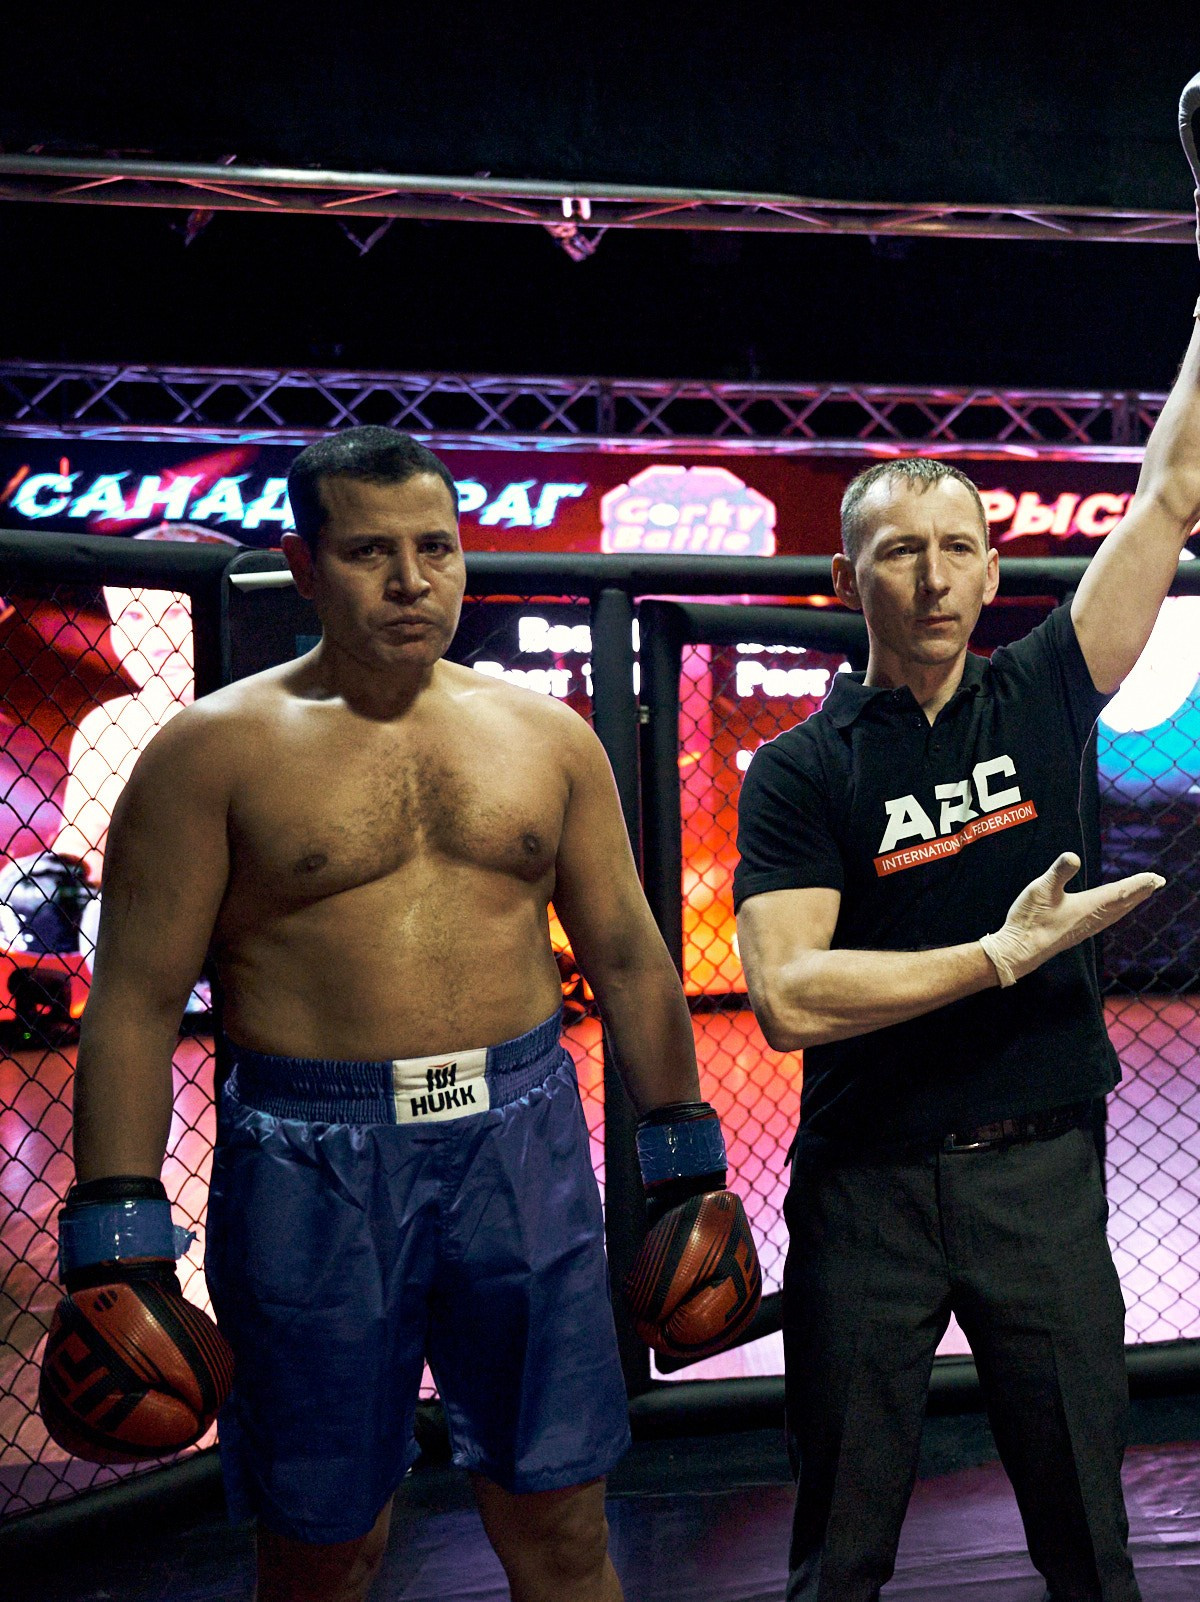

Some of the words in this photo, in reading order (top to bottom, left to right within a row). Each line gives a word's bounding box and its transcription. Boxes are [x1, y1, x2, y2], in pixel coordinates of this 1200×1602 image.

[453, 478, 588, 529] РАГ
[979, 489, 1136, 541] РЫС
[878, 755, 1021, 853] ARC
[882, 831, 972, 871] INTERNATIONAL
[972, 805, 1033, 837] FEDERATION
[410, 1085, 476, 1117] HUKK
